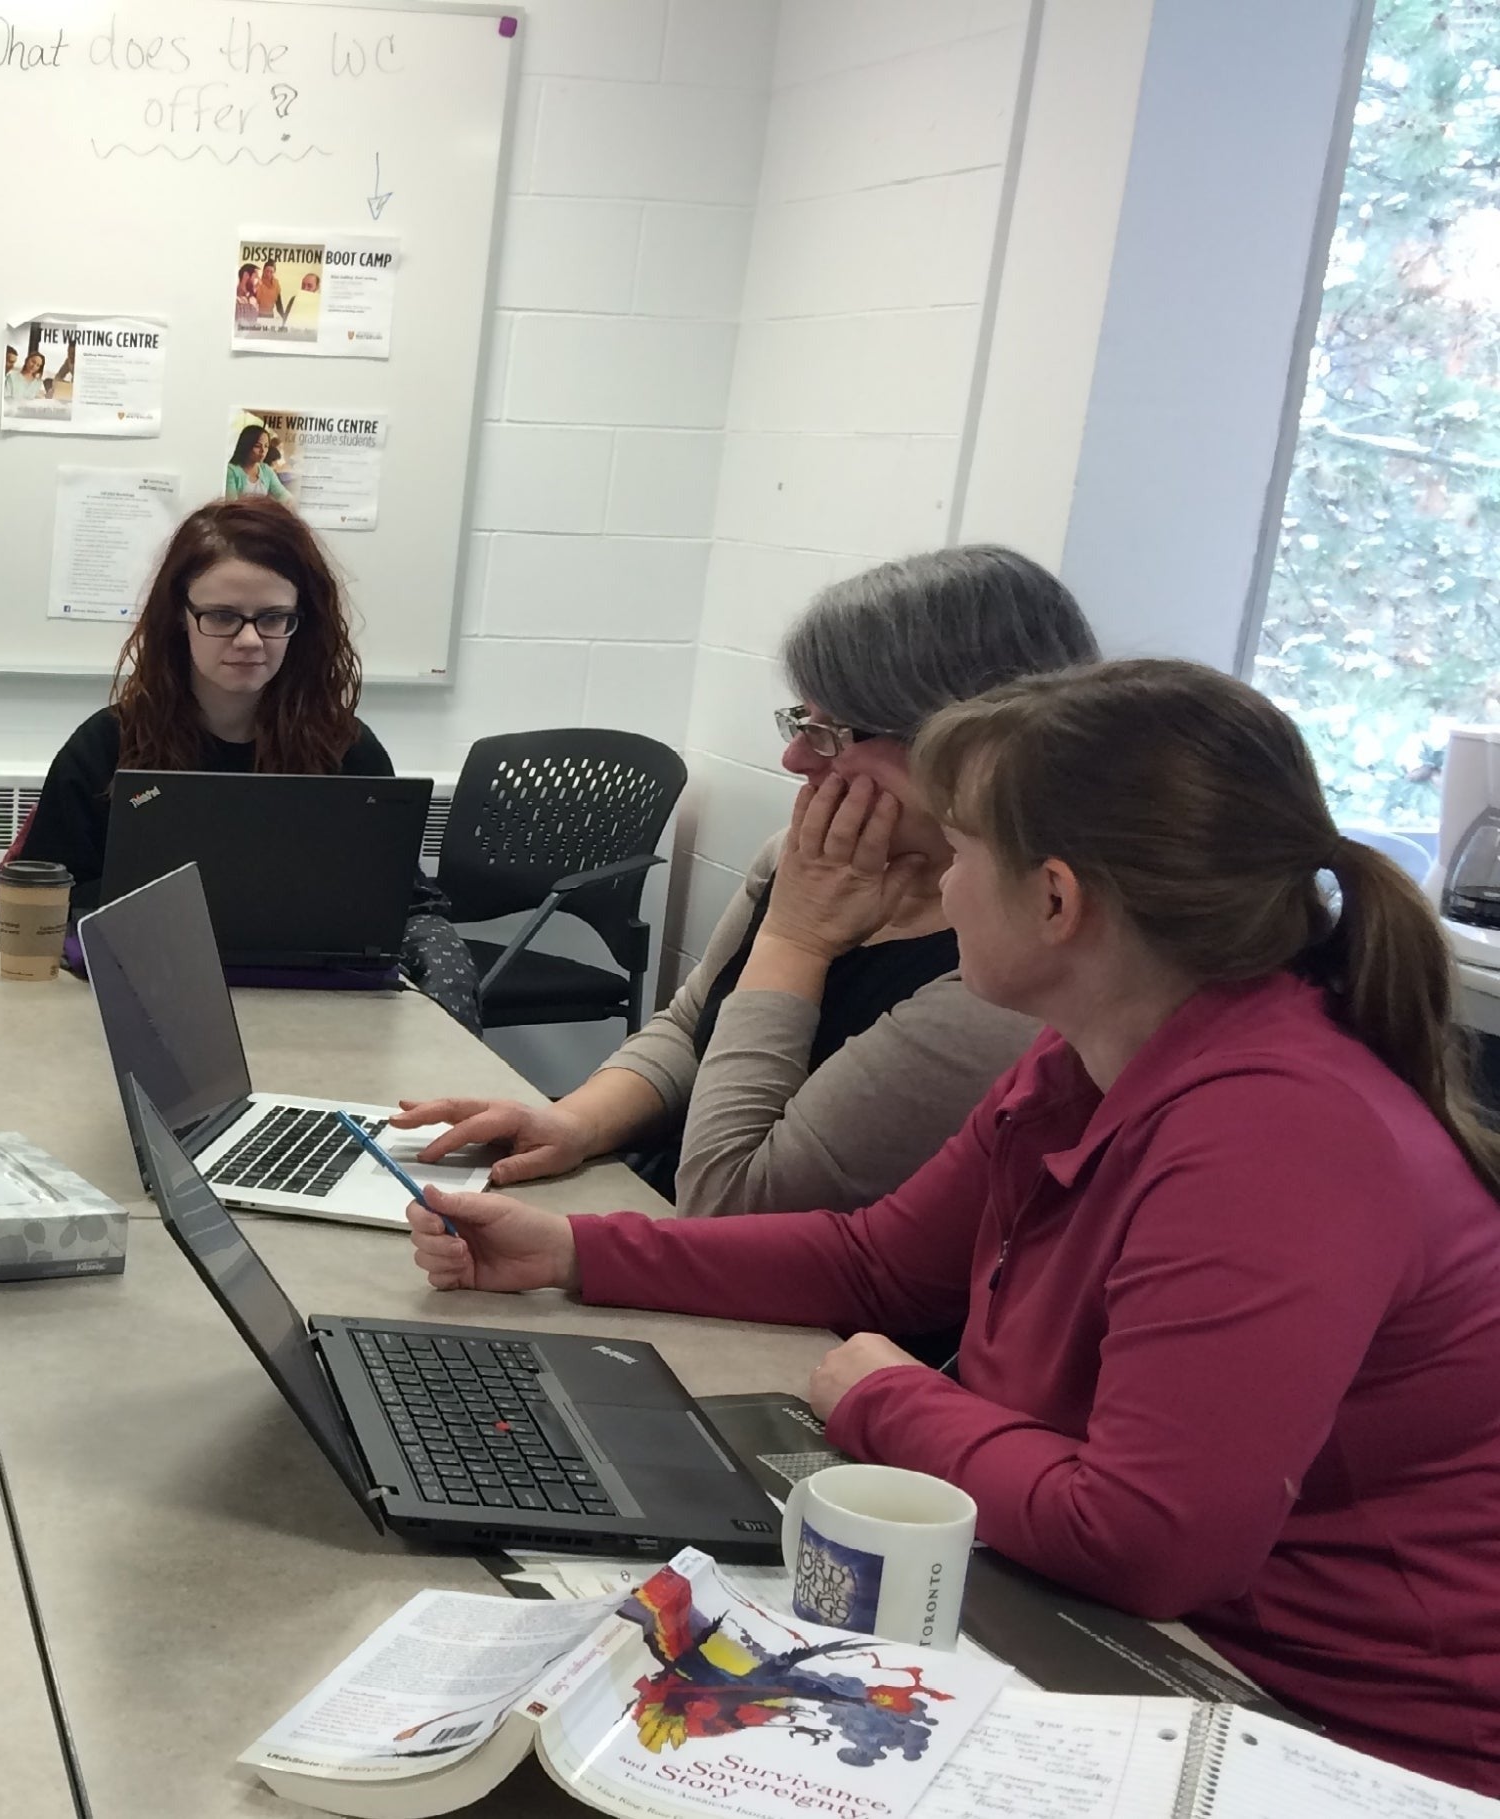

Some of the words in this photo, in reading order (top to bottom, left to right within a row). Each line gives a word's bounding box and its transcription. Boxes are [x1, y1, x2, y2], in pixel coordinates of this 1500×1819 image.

[89, 12, 190, 72] does
[220, 16, 289, 73] the
[331, 31, 406, 77] WC
[241, 246, 323, 264] DISSERTATION
[325, 251, 357, 266] BOOT
[359, 252, 392, 268] CAMP
[38, 328, 59, 344] THE
[62, 329, 113, 347] WRITING
[116, 332, 160, 349] CENTRE
[263, 415, 283, 430] THE
[286, 416, 334, 433] WRITING
[337, 418, 379, 434] CENTRE
[299, 433, 338, 446] graduate
[339, 434, 376, 448] students
[919, 1562, 942, 1647] TORONTO
[618, 1754, 648, 1772] and
[655, 1764, 739, 1799] Story
[718, 1754, 892, 1815] Survivance,
